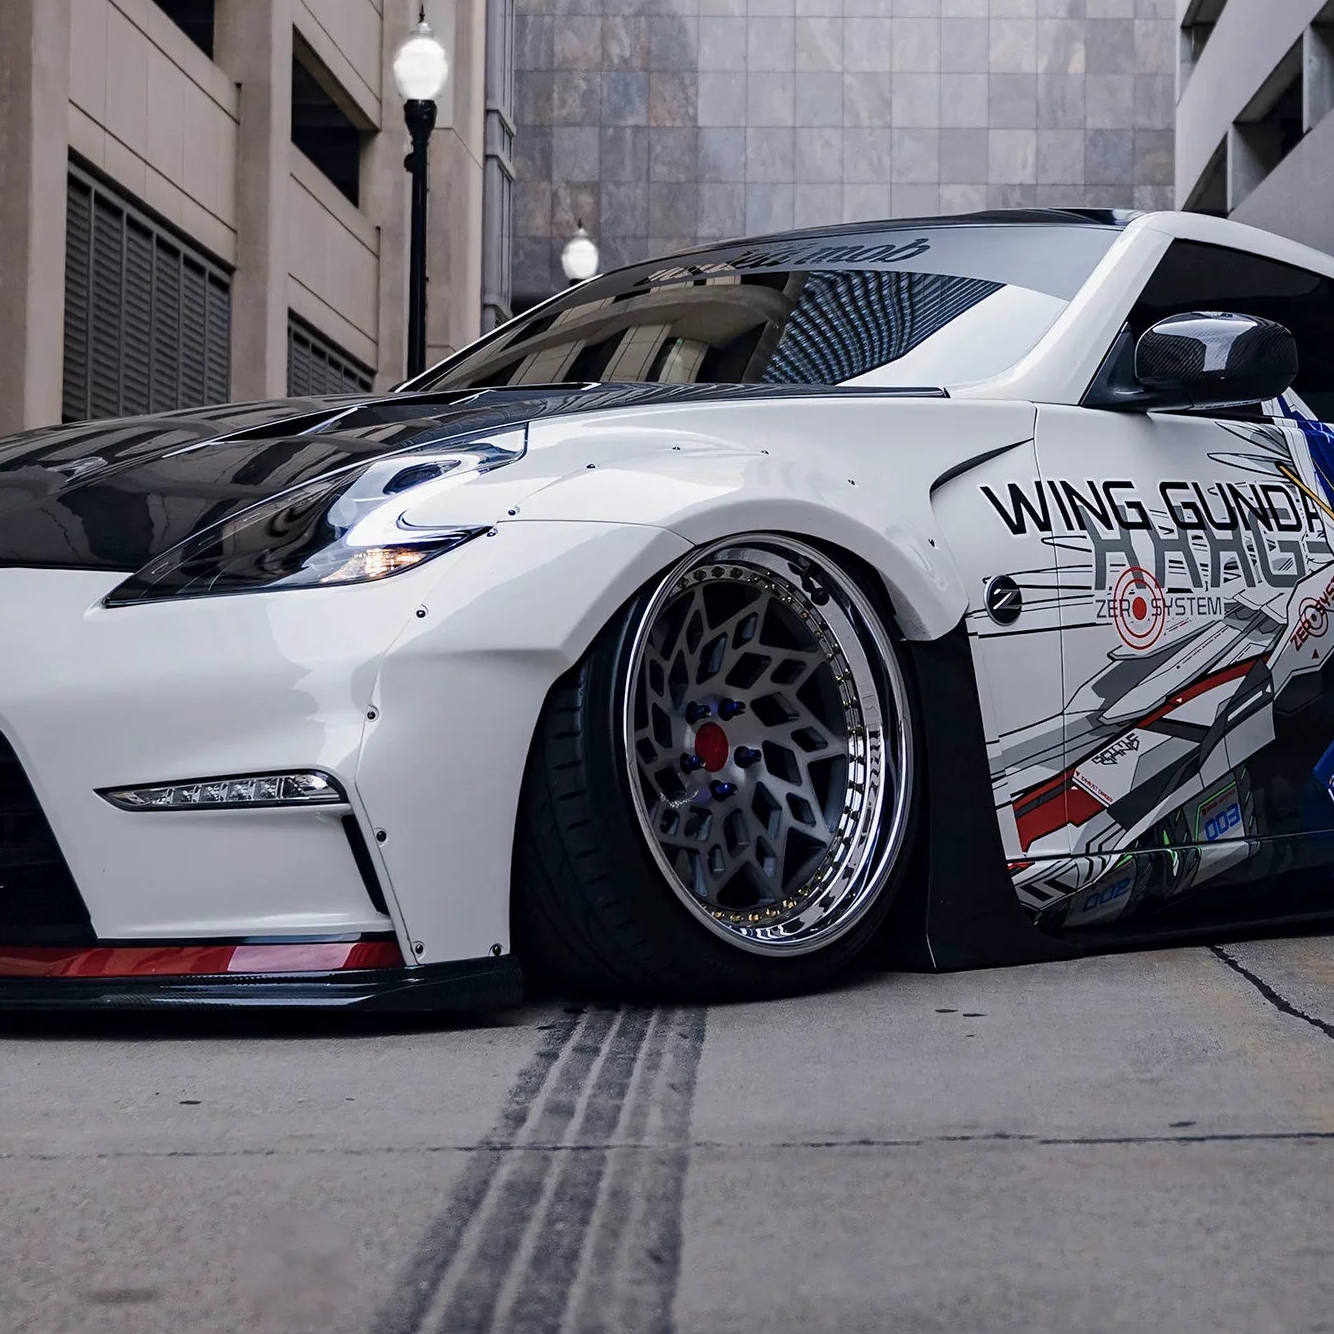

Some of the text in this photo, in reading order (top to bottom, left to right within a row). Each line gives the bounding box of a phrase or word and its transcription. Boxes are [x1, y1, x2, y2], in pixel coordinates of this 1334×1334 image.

[979, 480, 1153, 535] WING
[1151, 596, 1223, 618] SYSTEM
[1204, 803, 1241, 841] 003
